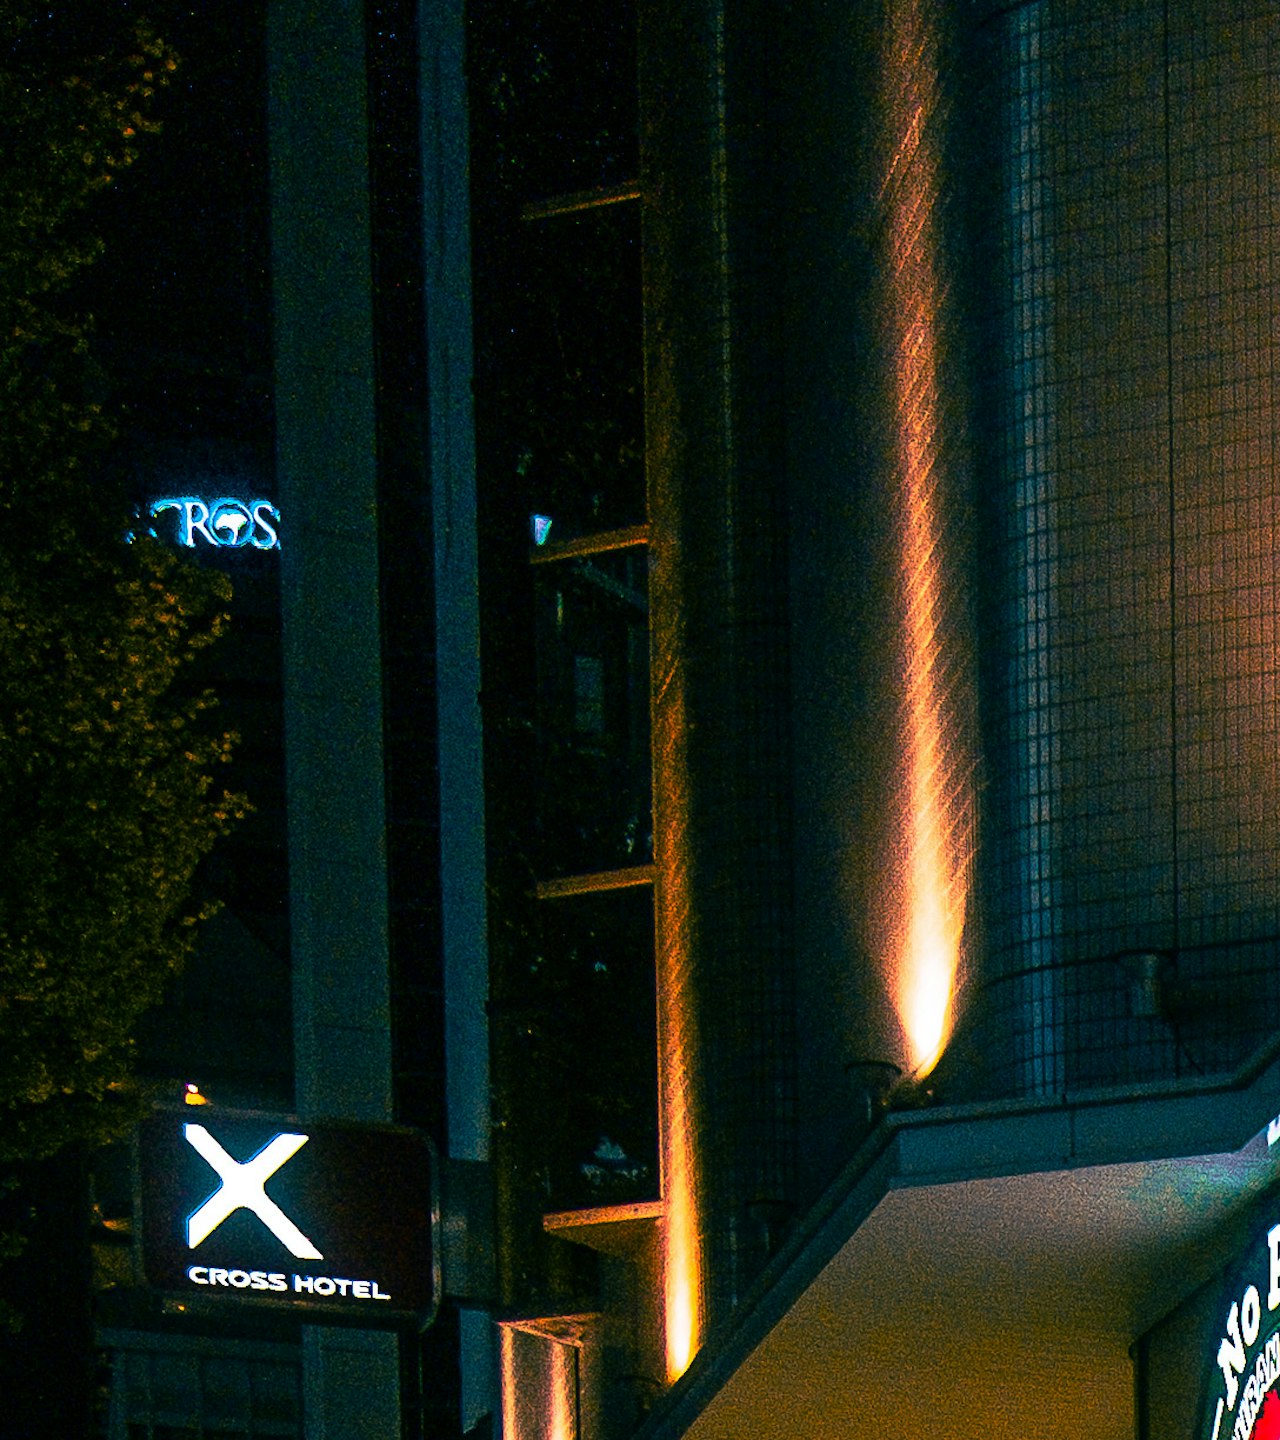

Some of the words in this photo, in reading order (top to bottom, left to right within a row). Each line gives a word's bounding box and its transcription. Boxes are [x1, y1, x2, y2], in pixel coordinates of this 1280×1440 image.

[188, 1266, 288, 1292] CROSS
[293, 1274, 391, 1301] HOTEL
[1216, 1276, 1261, 1412] No
